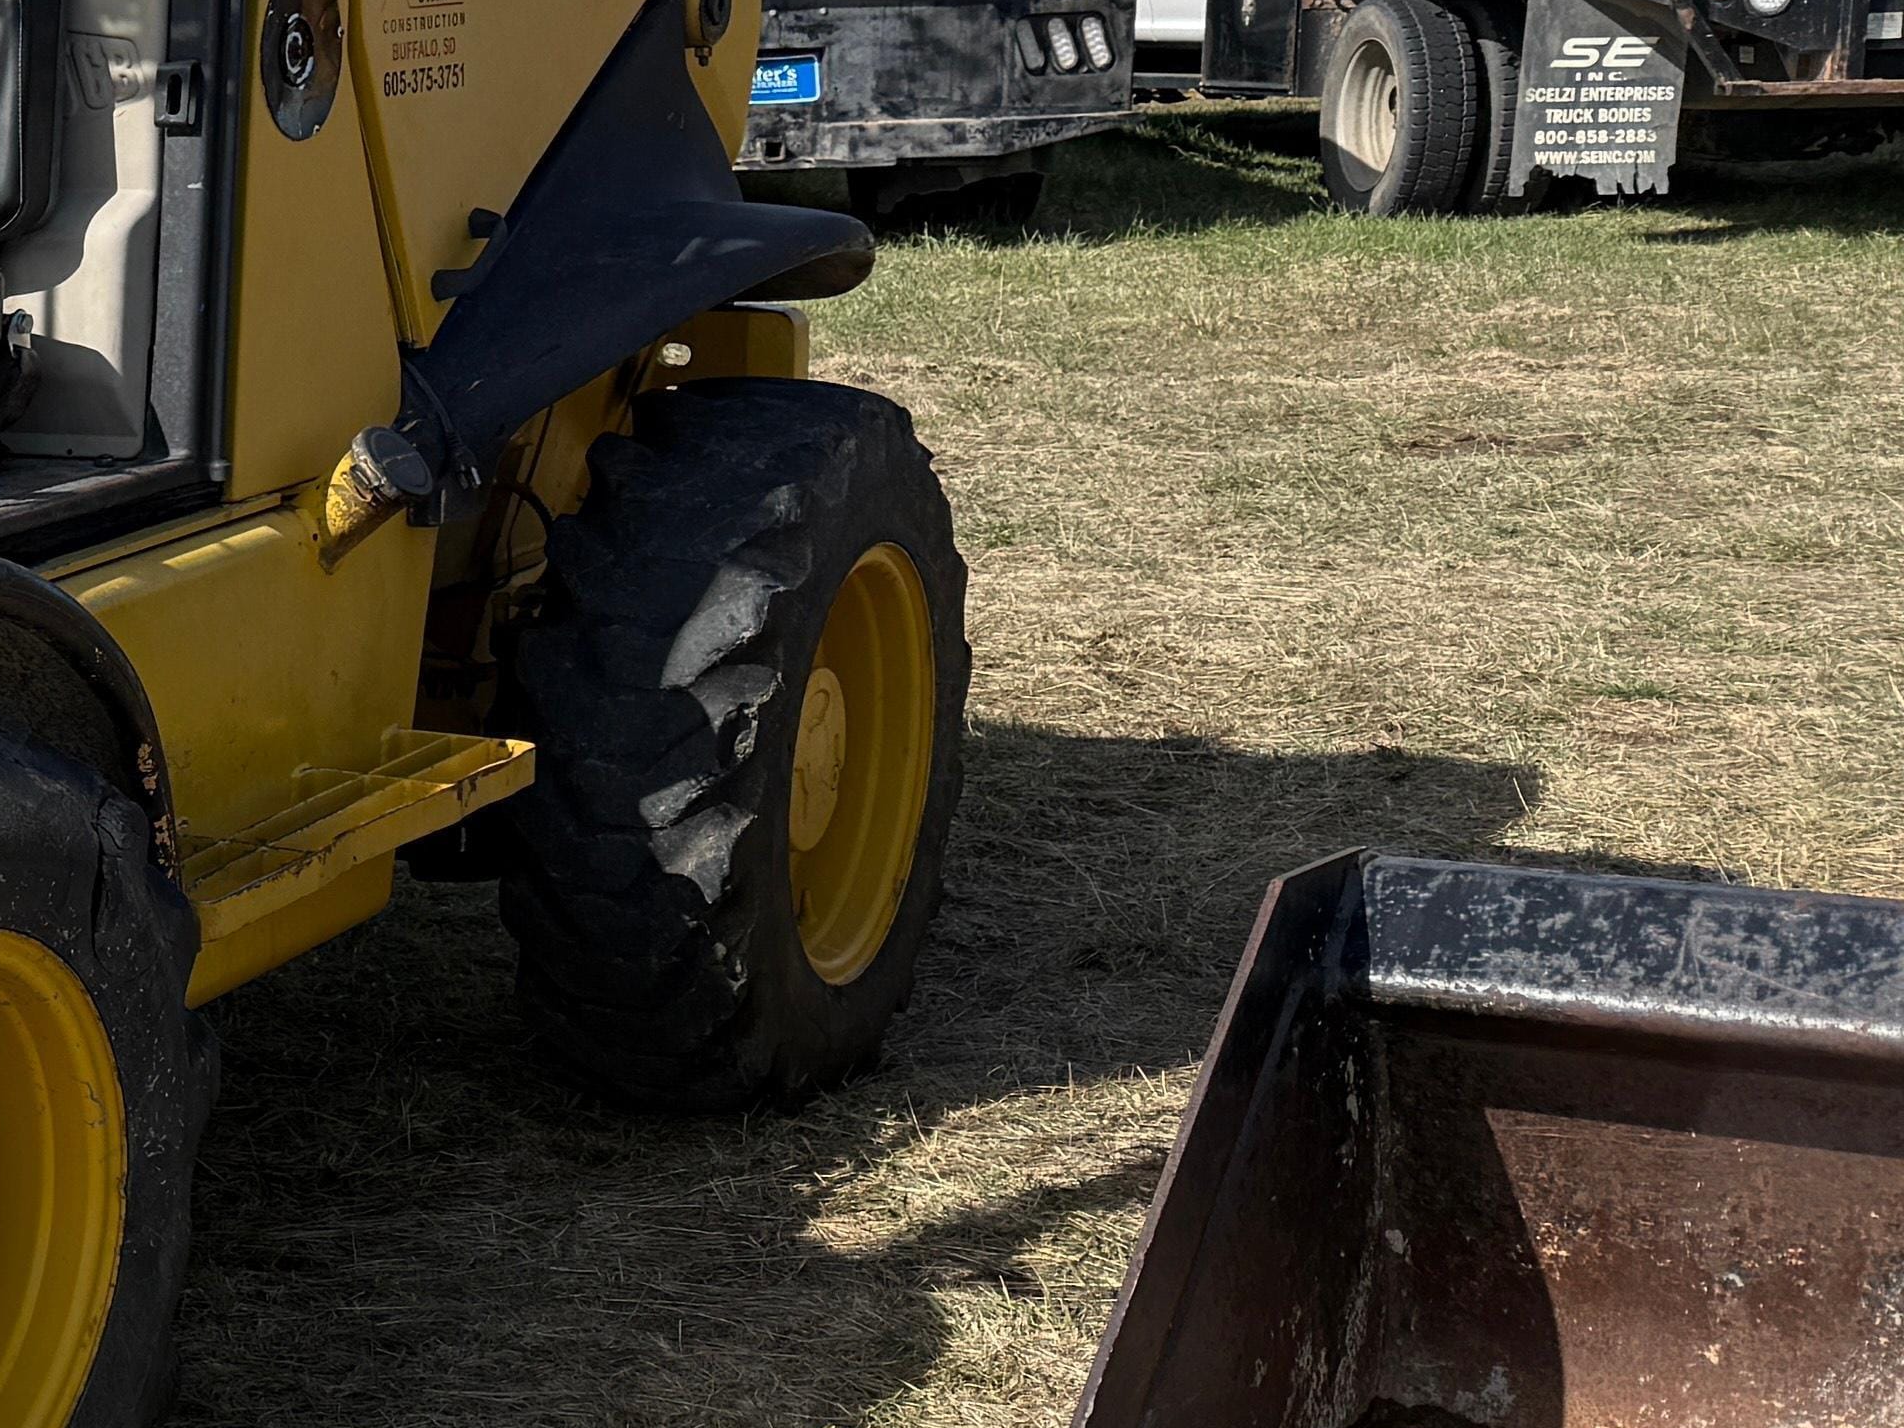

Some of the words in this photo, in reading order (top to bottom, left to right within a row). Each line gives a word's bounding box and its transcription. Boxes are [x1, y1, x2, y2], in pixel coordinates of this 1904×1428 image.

[382, 12, 466, 34] CONSTRUCTION
[392, 39, 441, 61] BUFFALO,
[442, 37, 457, 55] SD
[1549, 36, 1660, 68] SE
[383, 62, 465, 97] 605-375-3751
[751, 64, 798, 84] fer's
[1525, 87, 1576, 103] SCELZI
[1579, 86, 1676, 102] ENTERPRISES
[1545, 108, 1594, 124] TRUCK
[1597, 107, 1652, 123] BODIES
[1533, 128, 1658, 145] 800-858-2883
[1533, 149, 1657, 165] WWW.SEINC.COM
